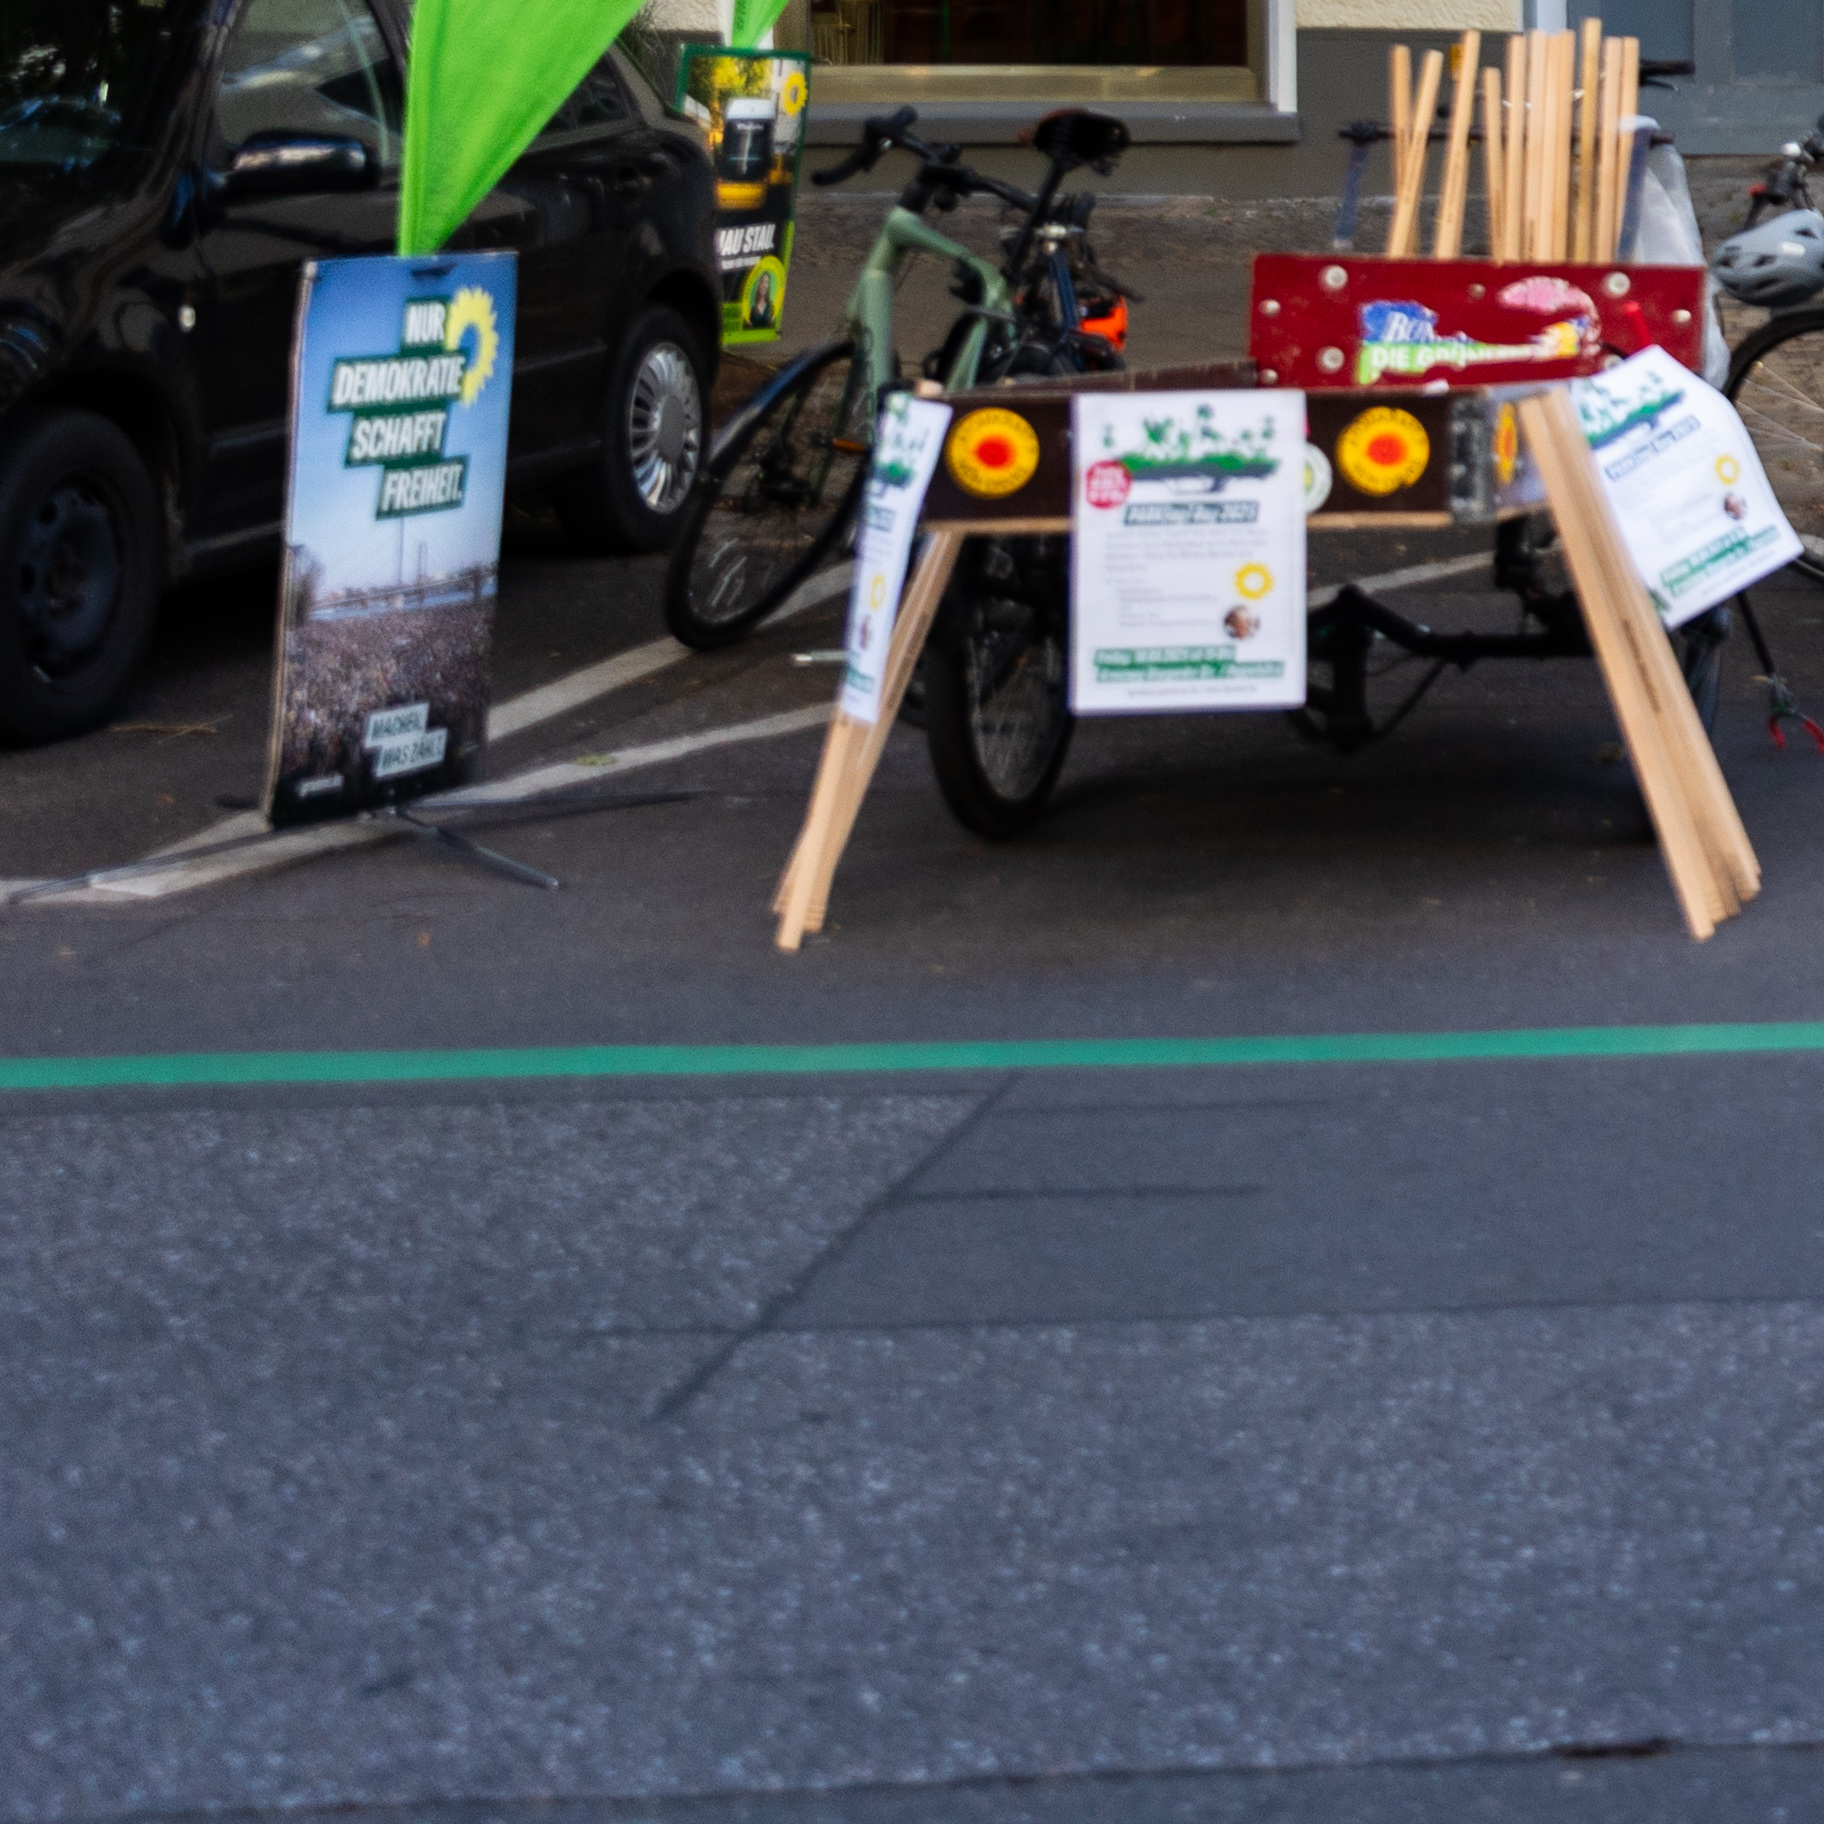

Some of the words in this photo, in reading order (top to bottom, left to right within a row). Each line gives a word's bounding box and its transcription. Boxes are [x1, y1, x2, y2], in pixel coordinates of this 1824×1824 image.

[405, 301, 447, 345] NUR
[330, 355, 467, 408] DEMOKRATIE
[350, 411, 447, 461] SCHAFFT
